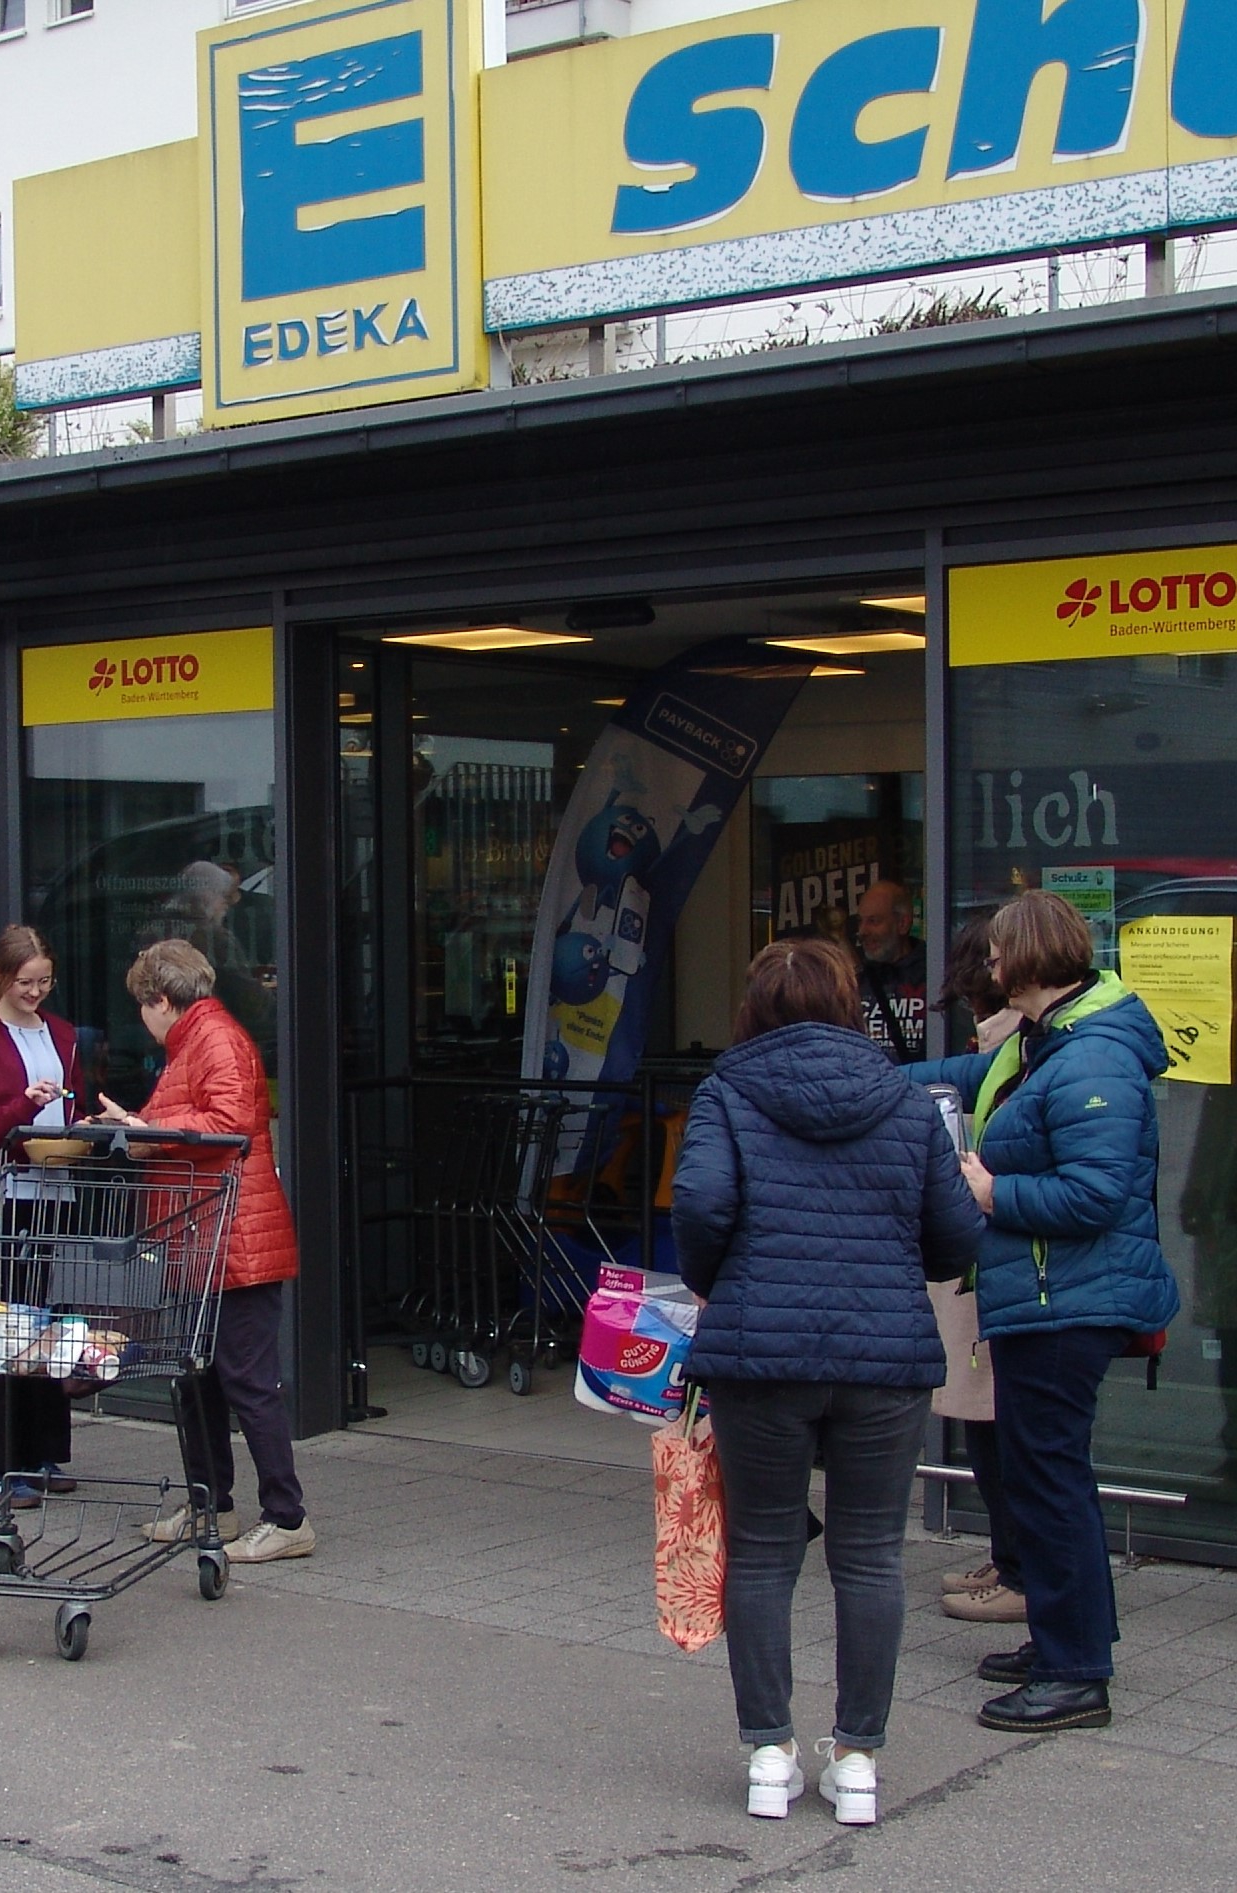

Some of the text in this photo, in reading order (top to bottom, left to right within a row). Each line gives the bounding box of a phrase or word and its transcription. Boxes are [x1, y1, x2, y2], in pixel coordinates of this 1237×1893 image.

[242, 298, 429, 367] EDEKA
[1110, 571, 1237, 614] LOTTO
[1110, 618, 1237, 637] Baden-Württemberg
[121, 654, 199, 686] LOTTO
[121, 690, 199, 704] Baden-Württemberg
[658, 707, 723, 750] PAYBACK
[779, 836, 879, 877] GOLDENER
[1128, 926, 1220, 937] ANKÜNDIGUNG!
[604, 1279, 635, 1291] öffnen
[606, 1272, 625, 1281] hier
[620, 1343, 661, 1369] GÜNSTIG
